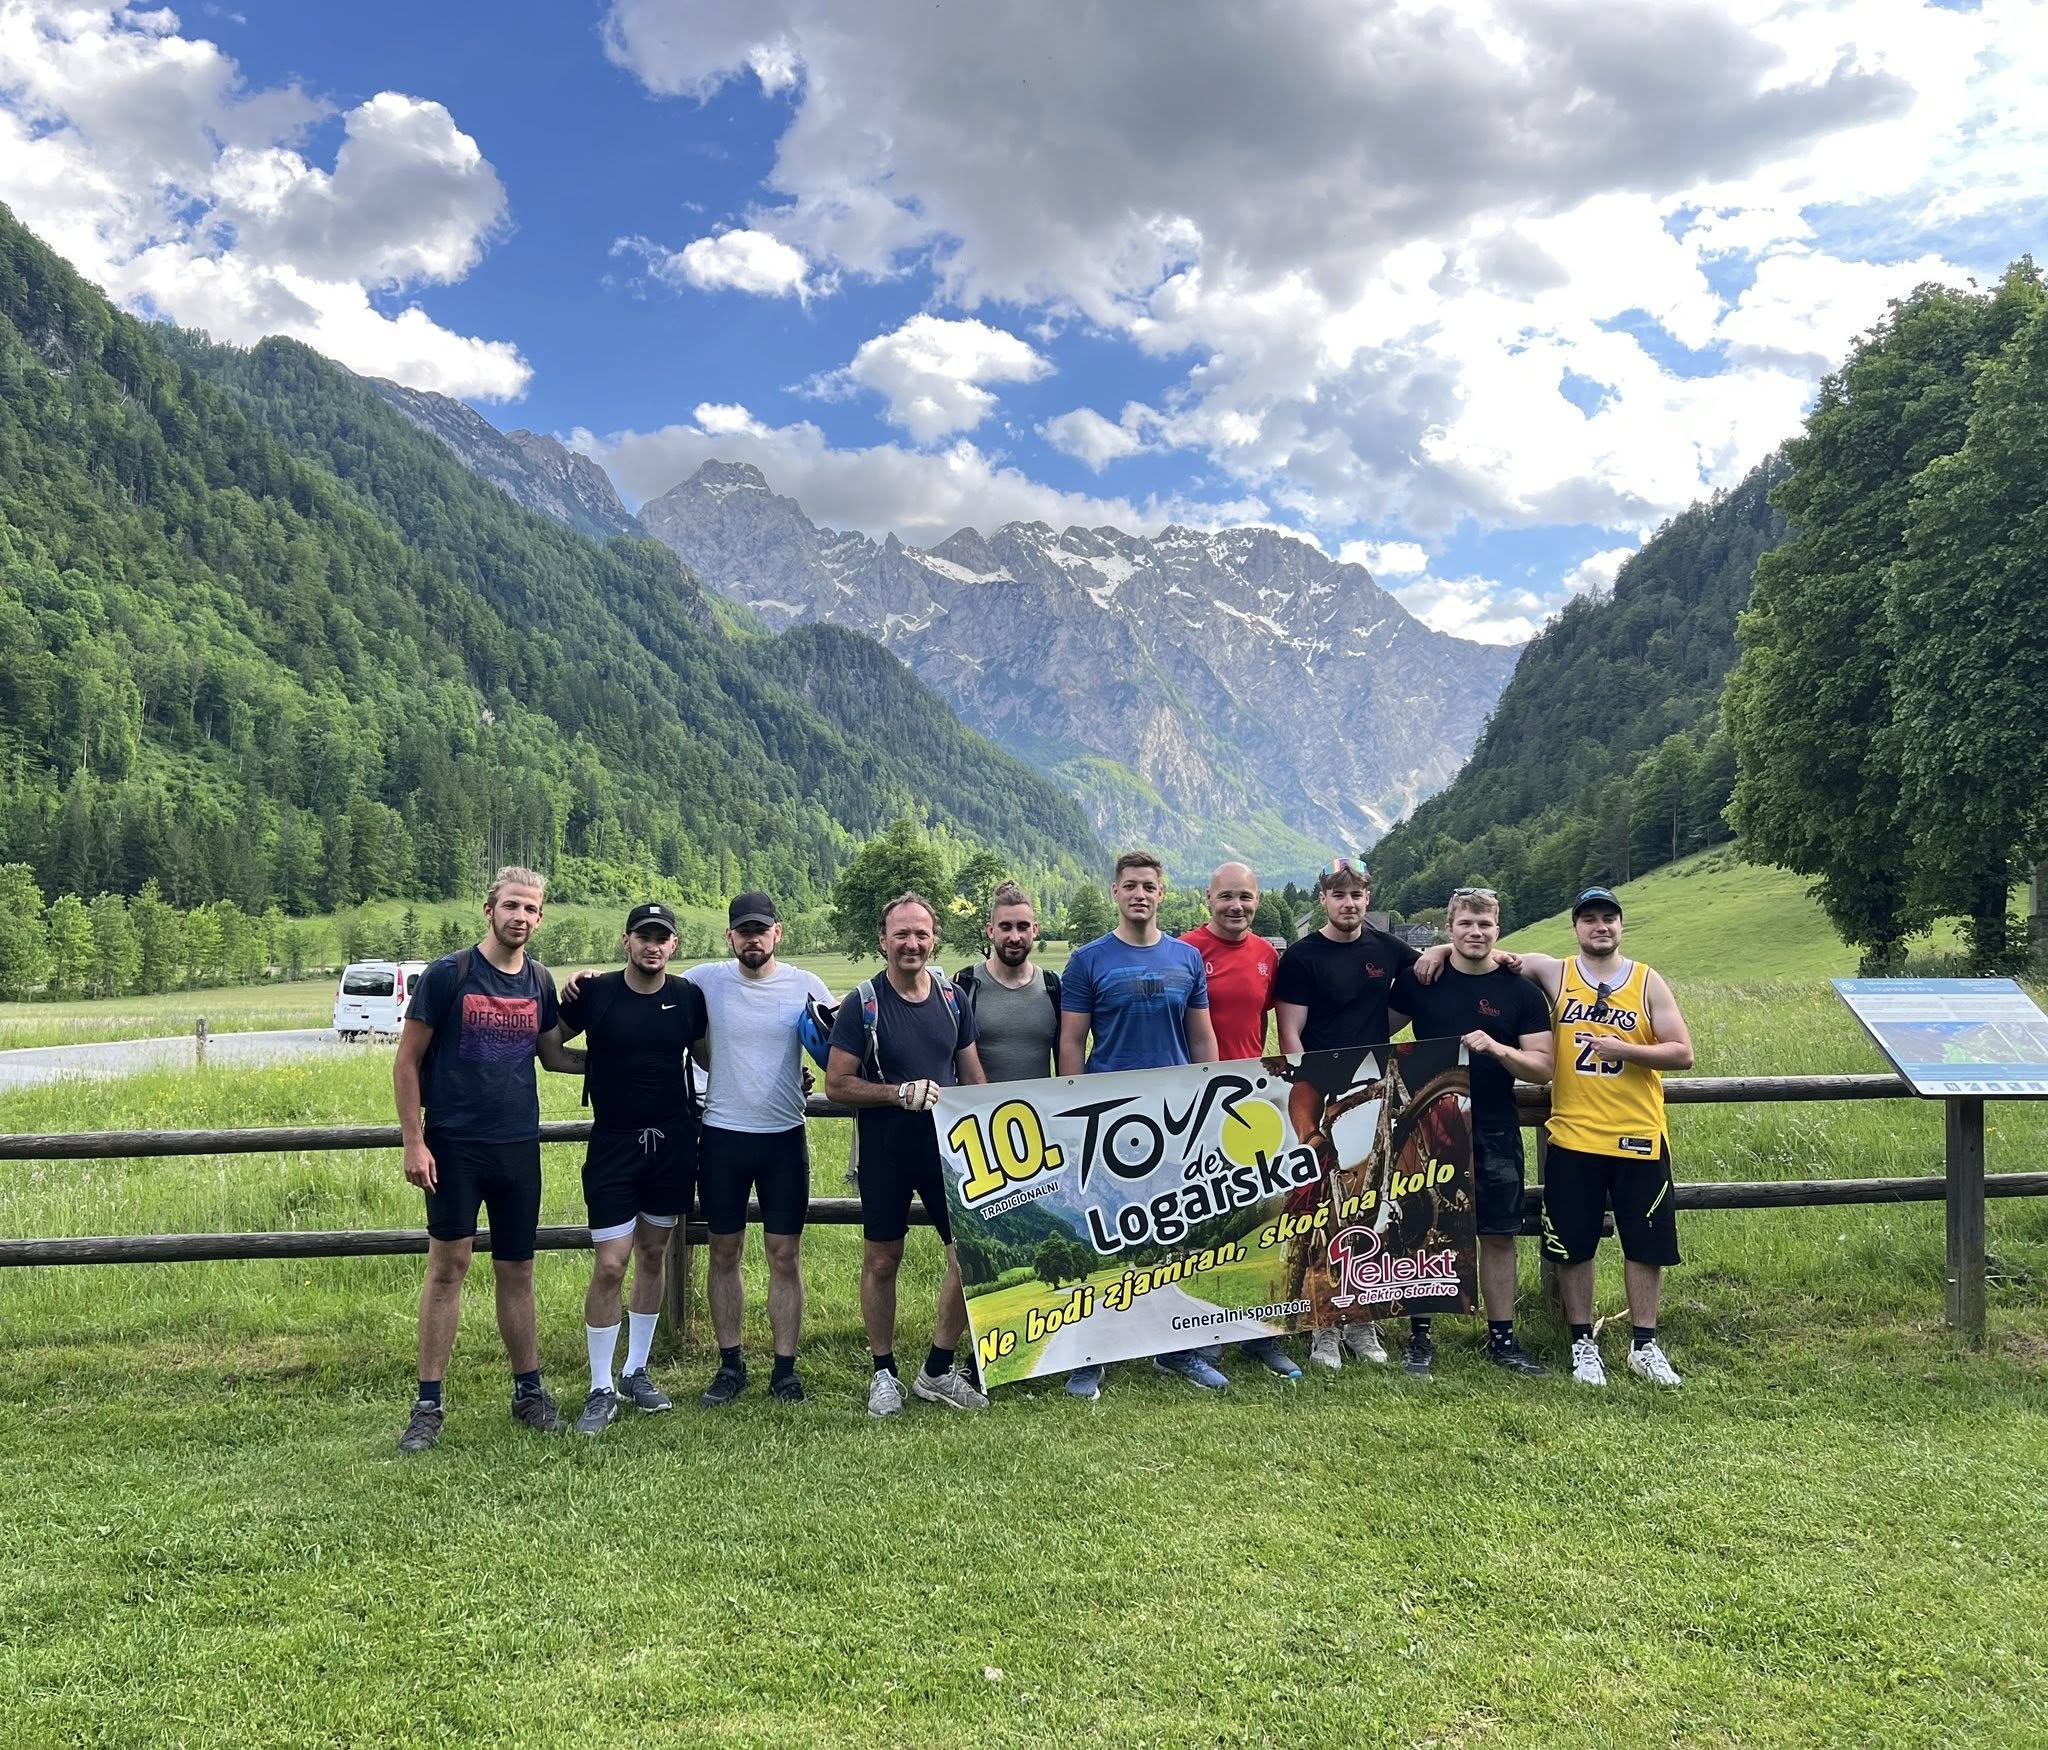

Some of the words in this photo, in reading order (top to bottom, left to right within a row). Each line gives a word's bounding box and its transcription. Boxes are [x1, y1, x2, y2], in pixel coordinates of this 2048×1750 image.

[469, 1010, 534, 1029] OFFSHORE
[948, 1099, 1064, 1203] 10.
[1184, 1144, 1222, 1181] de
[981, 1181, 1060, 1220] TRADICIONALNI
[1087, 1147, 1319, 1252] Logarska
[978, 1328, 1017, 1370] Ne
[1027, 1286, 1095, 1343] bodi
[1103, 1241, 1247, 1311] zjamran,
[1259, 1199, 1331, 1249] skoč
[1340, 1190, 1377, 1219] na
[1389, 1158, 1456, 1201] kolo
[1358, 1286, 1403, 1305] elektro
[1404, 1283, 1459, 1299] storitve
[1172, 1306, 1243, 1330] Generalni
[1247, 1299, 1311, 1321] sponzor:
